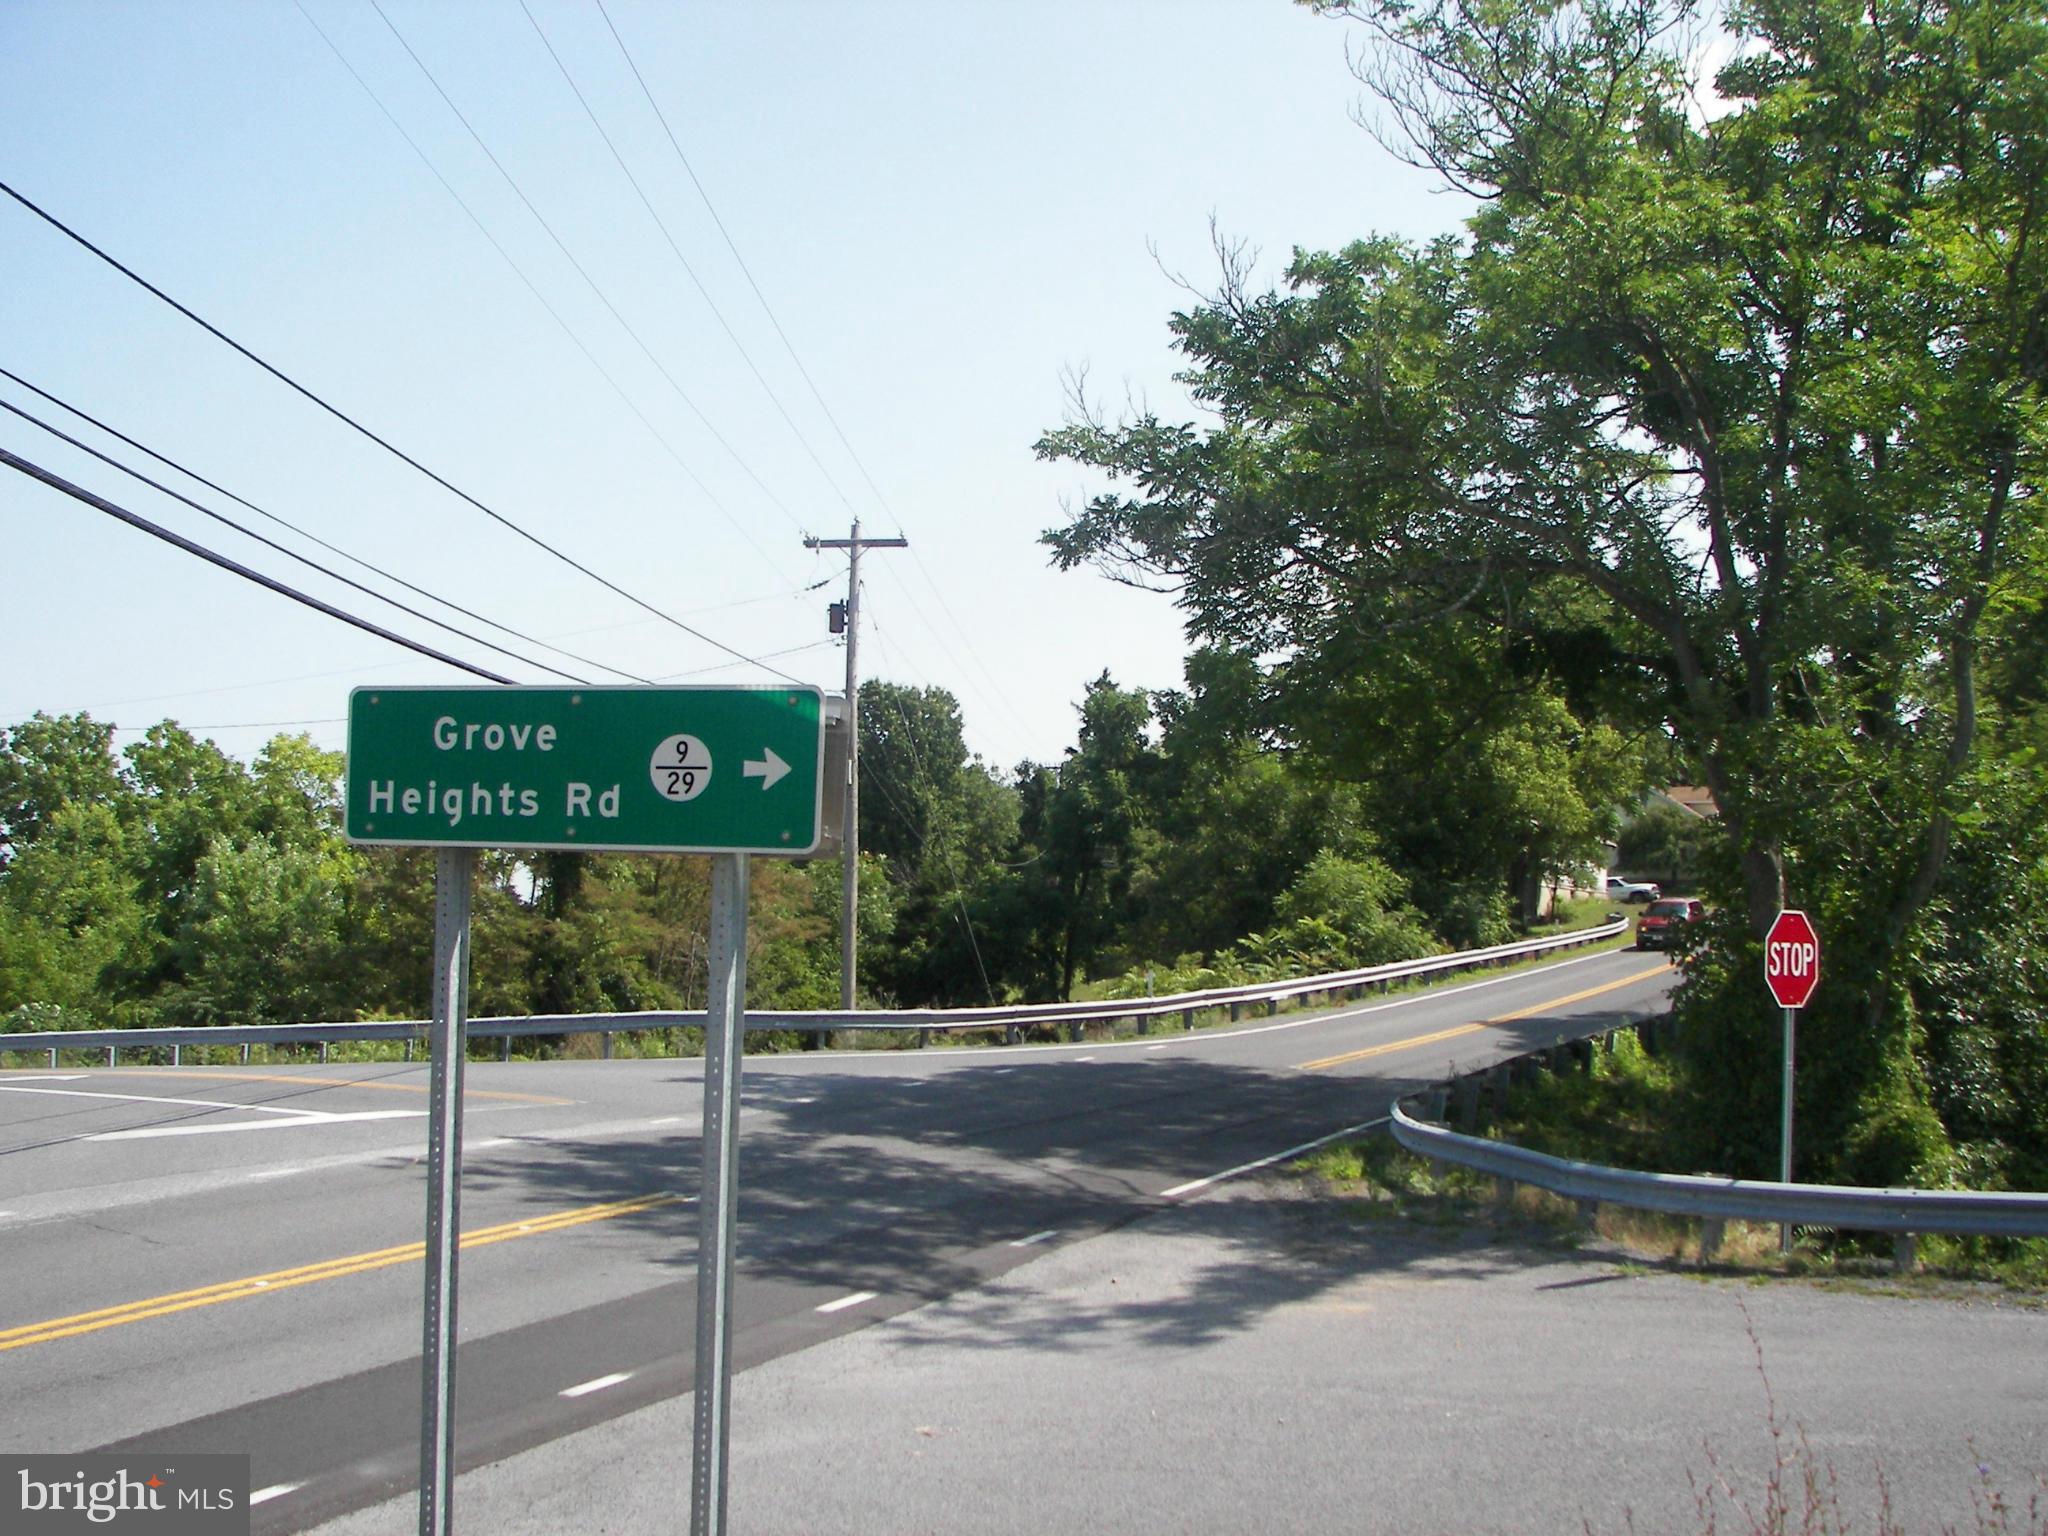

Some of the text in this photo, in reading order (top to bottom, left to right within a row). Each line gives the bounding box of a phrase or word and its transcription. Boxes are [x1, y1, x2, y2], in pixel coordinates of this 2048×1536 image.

[433, 715, 557, 751] Grove
[675, 740, 689, 764] 9
[667, 771, 695, 796] 29
[368, 780, 620, 827] Heights Rd
[1769, 941, 1815, 977] STOP
